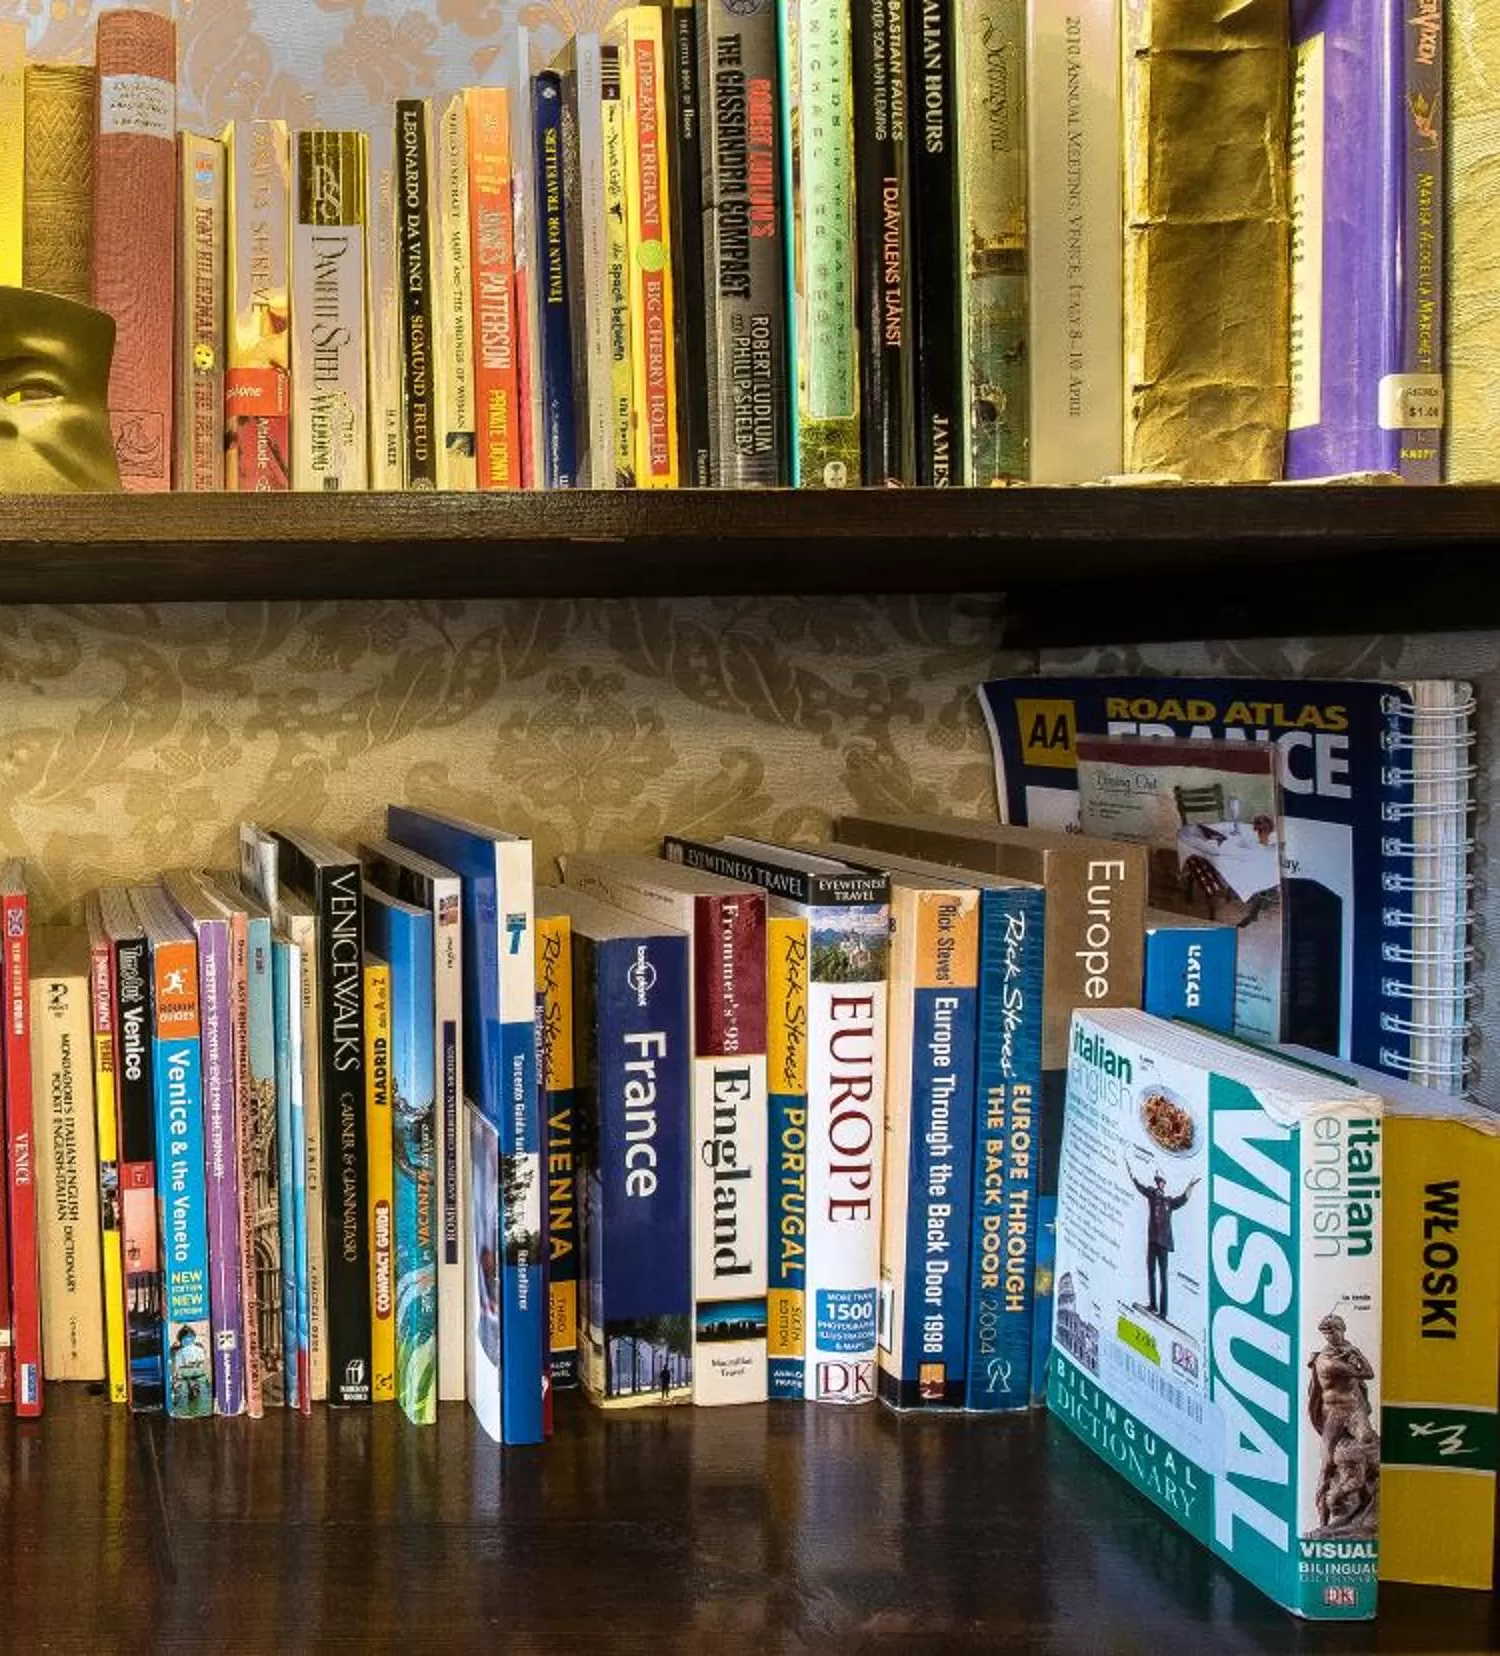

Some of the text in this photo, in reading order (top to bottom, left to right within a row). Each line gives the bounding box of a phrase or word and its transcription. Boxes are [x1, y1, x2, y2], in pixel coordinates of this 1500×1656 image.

[891, 80, 904, 141] FAULKS
[925, 74, 944, 154] HOURS
[643, 139, 660, 225] TRIGIANI
[716, 33, 751, 300] THE CASSANDRA COMPACT
[545, 127, 563, 304] ITALIAN FOR TRAVELLERS
[403, 111, 429, 461] LEONARDO DA VINCI SIGMUND FREUD
[480, 271, 512, 370] PATTERSON
[647, 281, 667, 465] BIG CHERRY HOLLER
[732, 337, 754, 456] PHILIP SHELBY
[751, 315, 773, 453] ROBERT LUDLUM
[932, 414, 950, 488] JAMES
[1028, 713, 1072, 750] AA
[1106, 698, 1347, 730] ROAD ATLAS
[687, 848, 806, 900] EYEWITNESS TRAVEL
[834, 890, 875, 903] TRAVEL
[786, 932, 807, 999] Rick
[935, 904, 957, 986] Rick Steves'
[1002, 910, 1026, 983] Rick
[1075, 860, 1125, 999] Europe
[331, 871, 363, 1072] VENICEWALKS
[1185, 944, 1202, 1009] העולם
[99, 1039, 113, 1073] VENICE
[124, 1005, 147, 1081] Venice
[373, 1038, 387, 1106] MADRID
[512, 1053, 524, 1103] Tarcento
[1073, 1023, 1132, 1085] italian
[623, 1030, 668, 1198] France
[828, 991, 875, 1223] EUROPE
[14, 1132, 30, 1186] VENICE
[167, 1048, 193, 1261] Venice & the Veneto
[547, 1108, 574, 1261] VIENNA
[701, 1064, 753, 1281] England
[781, 1106, 807, 1278] PORTUGAL
[923, 996, 958, 1353] Europe Through the Back Door 1998
[981, 1083, 1005, 1289] THE BACK DOOR
[1302, 1115, 1350, 1259] english
[1346, 1116, 1381, 1257] italian
[445, 1205, 457, 1242] ROME
[1004, 1084, 1033, 1312] EUROPE THROUGH
[62, 1225, 77, 1294] DICTIONARY
[171, 1270, 202, 1285] NEW
[172, 1294, 203, 1307] NEW
[375, 1206, 390, 1313] COMPACT GUIDE
[1420, 1179, 1461, 1340] WŁOSKI
[779, 1298, 791, 1347] EDITION
[825, 1302, 874, 1320] 1500
[979, 1298, 999, 1355] 2004
[1210, 1106, 1294, 1552] VISUAL
[822, 1362, 872, 1396] DK
[1056, 1356, 1198, 1491] BILINGUAL
[1056, 1386, 1198, 1520] DICTIONARY
[1299, 1560, 1379, 1576] BILINGUAL
[1300, 1541, 1379, 1560] VISUAL
